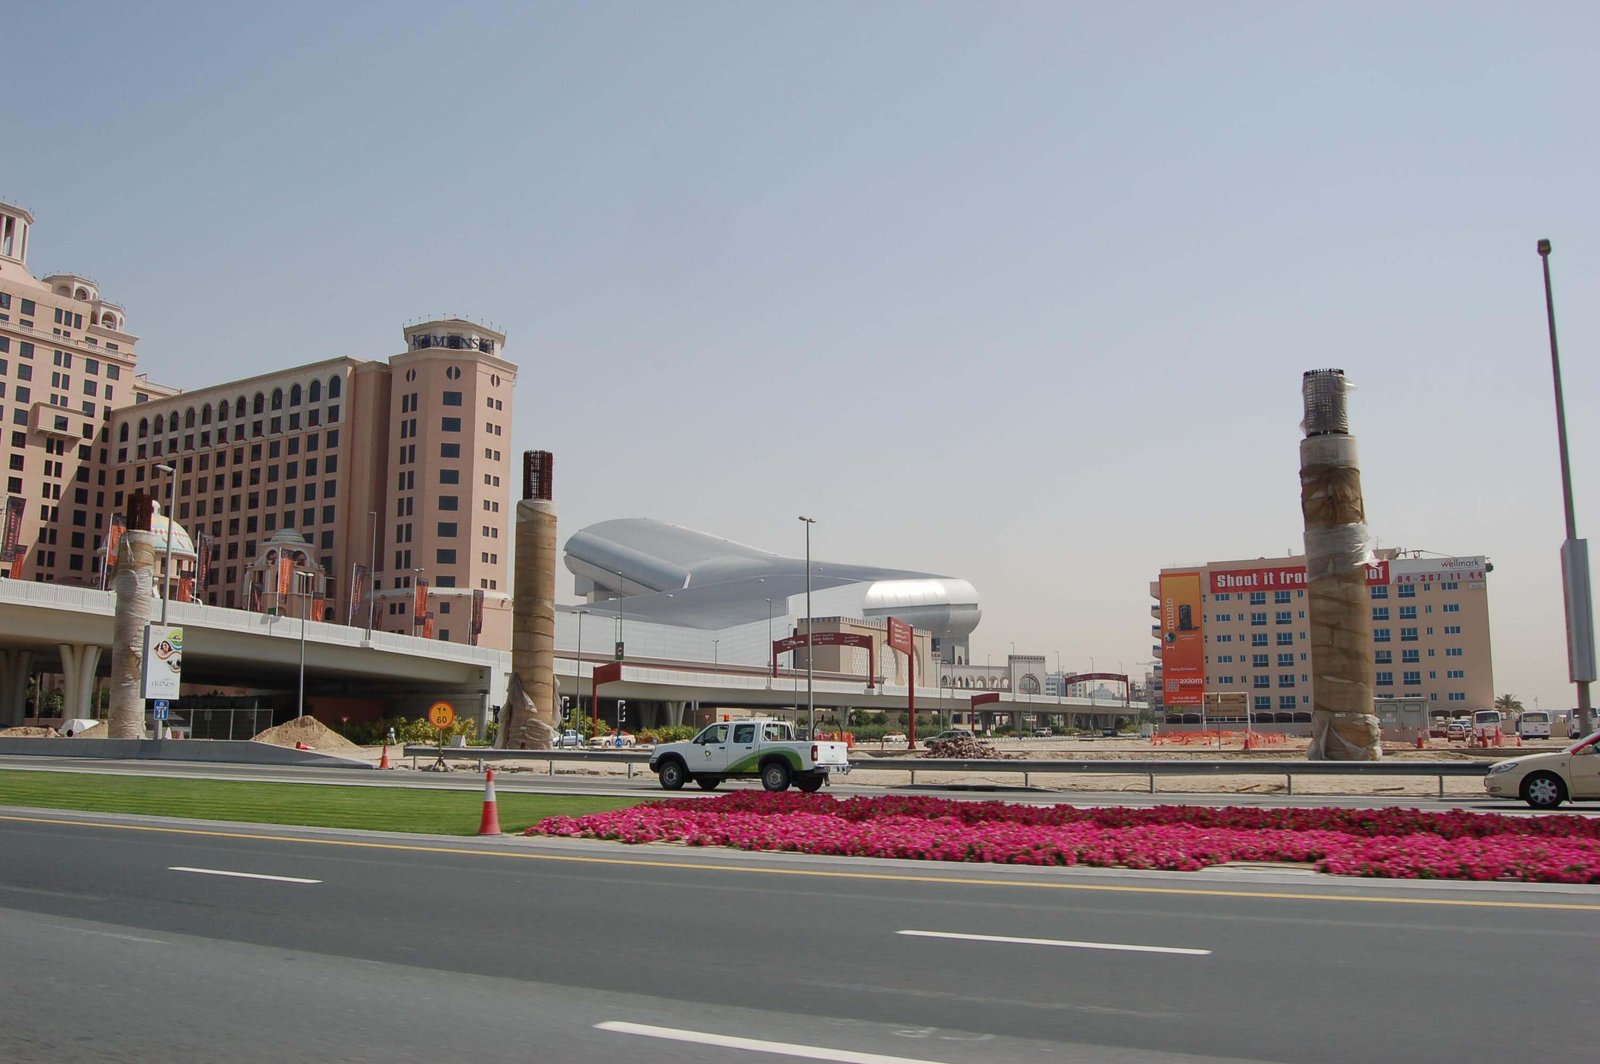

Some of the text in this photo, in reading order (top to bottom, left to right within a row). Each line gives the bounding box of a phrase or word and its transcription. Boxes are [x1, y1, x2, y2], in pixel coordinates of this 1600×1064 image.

[1217, 573, 1258, 588] Shoot
[1263, 572, 1275, 585] it
[1166, 598, 1174, 629] music
[1179, 677, 1203, 685] axiom
